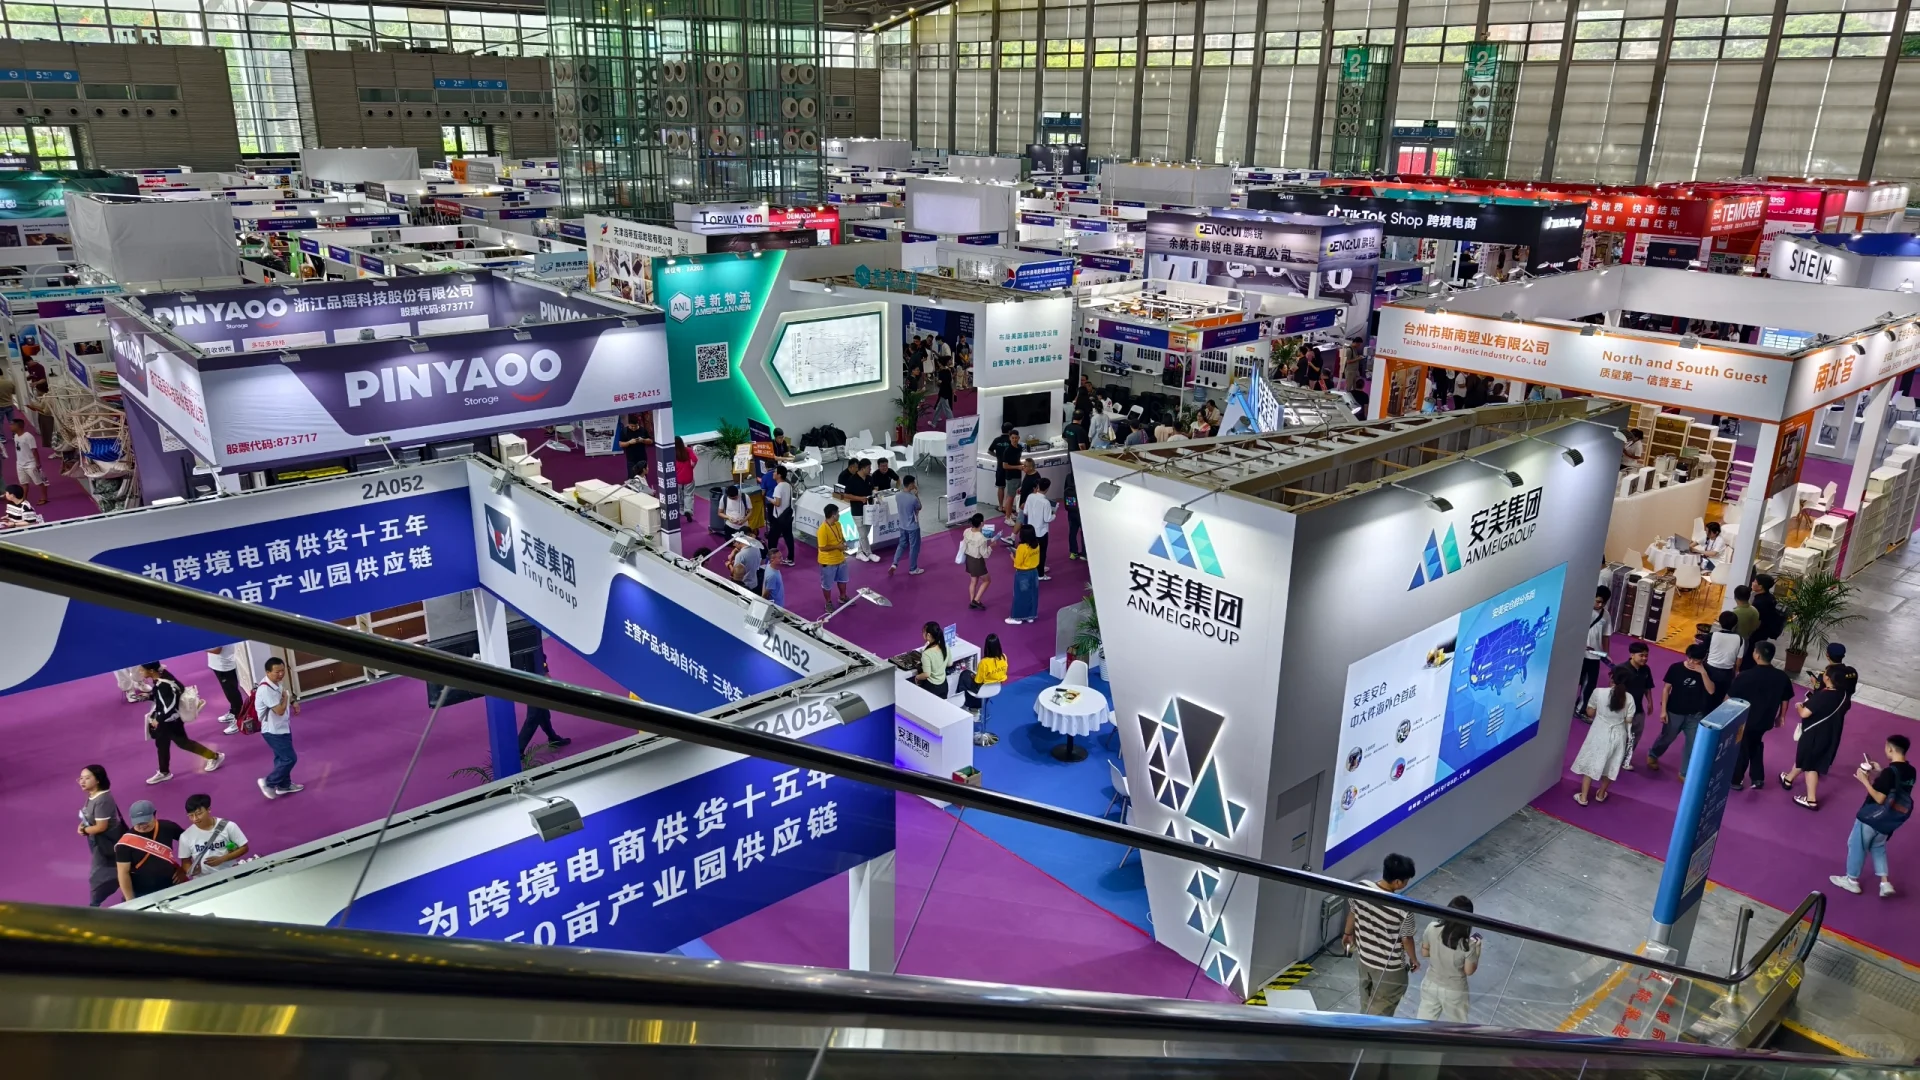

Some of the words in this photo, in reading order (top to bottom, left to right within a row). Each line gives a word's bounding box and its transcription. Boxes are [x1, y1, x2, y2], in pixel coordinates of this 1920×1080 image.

[1350, 54, 1361, 73] 2
[1476, 51, 1488, 71] 2
[1390, 211, 1424, 229] Shop
[1426, 213, 1478, 230] 跨境电商
[1626, 216, 1678, 230] 流量红利
[1632, 203, 1680, 216] 快速结账
[1722, 200, 1763, 222] TEMU专区
[1169, 236, 1291, 261] 余姚市鹏锐电器有限公司
[1790, 248, 1833, 281] SHEIN
[153, 297, 288, 326] PINYAOO
[294, 285, 474, 313] 浙江品瑶科技股份有限公司
[400, 301, 475, 317] 股票代码:873717
[673, 302, 690, 312] ANL
[695, 290, 751, 309] 美新物流
[1402, 338, 1430, 348] Taizhou
[1432, 342, 1452, 352] Sinan
[1454, 344, 1479, 356] Plastic
[1481, 347, 1514, 362] Industry
[1533, 357, 1547, 367] Ltd
[1404, 321, 1550, 356] 台州市斯南塑业有限公司
[344, 348, 562, 408] PINYAOO
[1600, 367, 1644, 383] 质量第一
[1647, 374, 1693, 391] 信誉至上
[1602, 351, 1643, 366] North
[1647, 359, 1672, 371] and
[1675, 361, 1719, 378] South
[1723, 369, 1768, 385] Guest
[464, 394, 499, 406] Storage
[613, 389, 661, 403] 展位号:2A215
[226, 432, 318, 455] 股票代码:873717
[361, 474, 425, 501] 2A052
[1467, 485, 1543, 548] 安美集团
[142, 513, 429, 583] 为跨境电商供货十五年
[520, 529, 577, 589] 天壹集团
[1463, 522, 1537, 568] ANMEIGROUP
[521, 560, 543, 589] Tiny
[546, 576, 578, 609] Group
[1129, 561, 1243, 630] 安美集团
[1127, 594, 1240, 645] ANMEIGROUP
[624, 619, 709, 686] 主营产品:电动自行车
[712, 672, 744, 702] 三轮车
[762, 628, 811, 673] 2A052
[898, 726, 930, 753] 安美集团
[418, 769, 838, 938] 为跨境电商供货十五年
